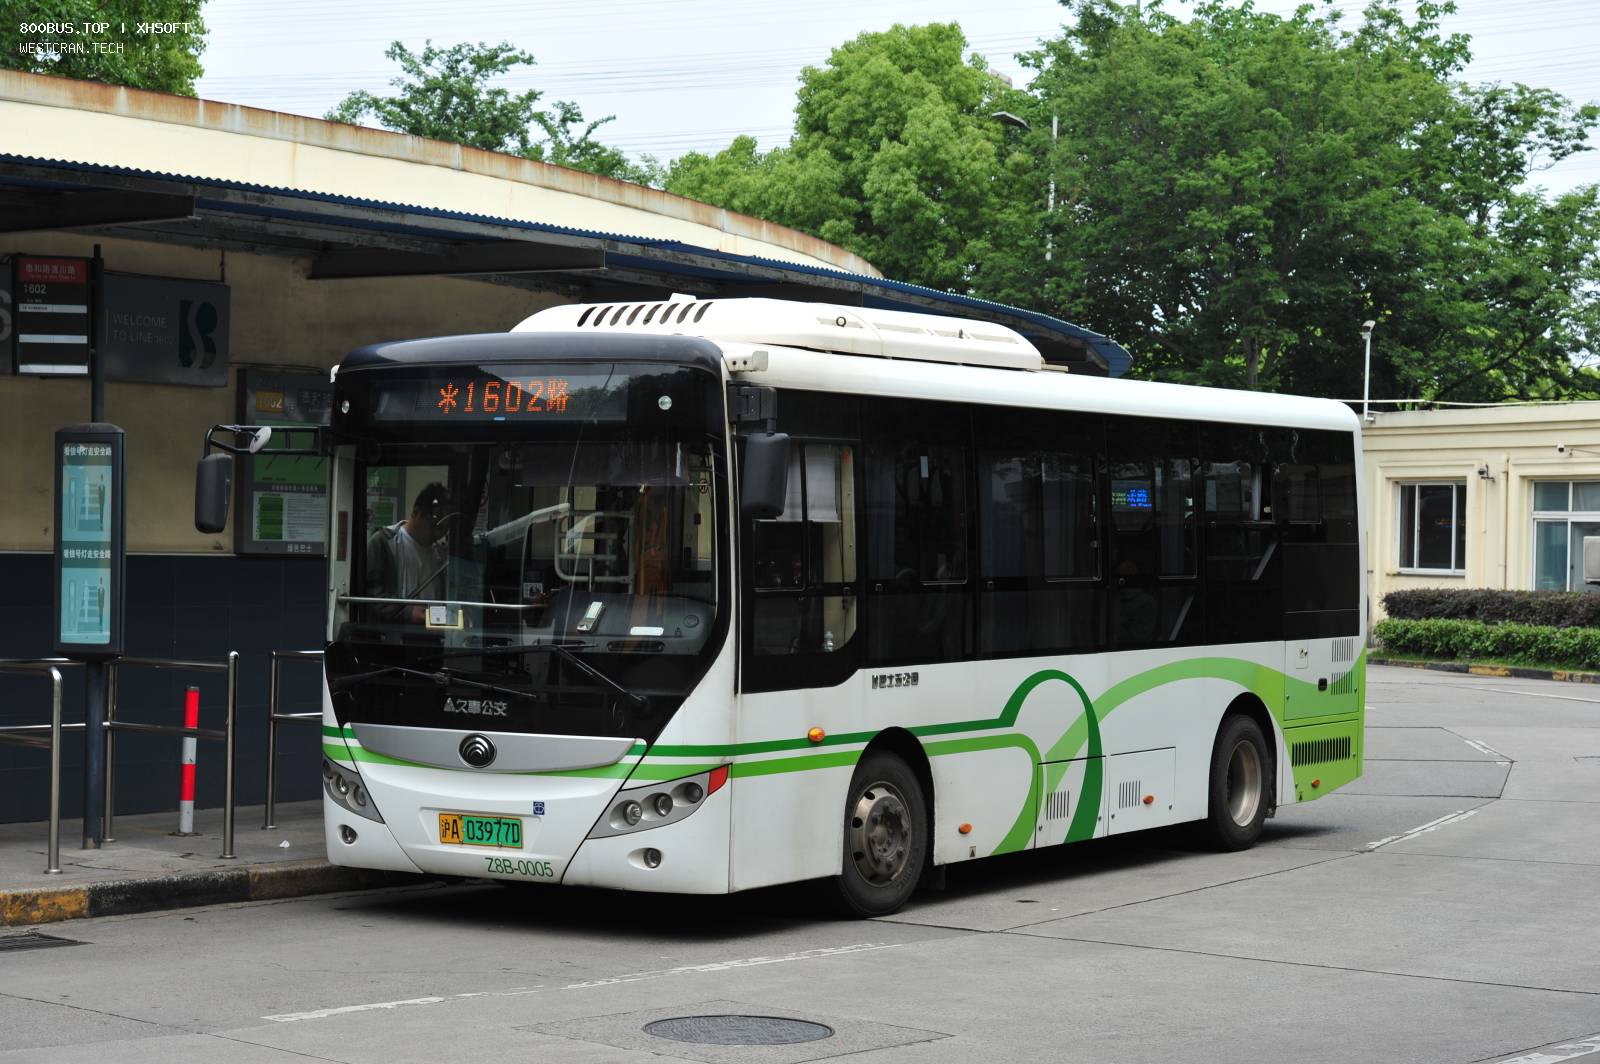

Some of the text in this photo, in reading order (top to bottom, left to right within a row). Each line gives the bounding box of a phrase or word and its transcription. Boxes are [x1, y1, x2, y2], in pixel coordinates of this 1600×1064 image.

[24, 283, 47, 294] 1602
[113, 313, 168, 329] WELCOME
[113, 329, 127, 342] TO
[130, 331, 153, 344] LINE
[64, 446, 112, 457] 看信号灯走安全路
[64, 548, 111, 560] 看信号灯走安全路
[484, 857, 554, 878] Z8B-0005
